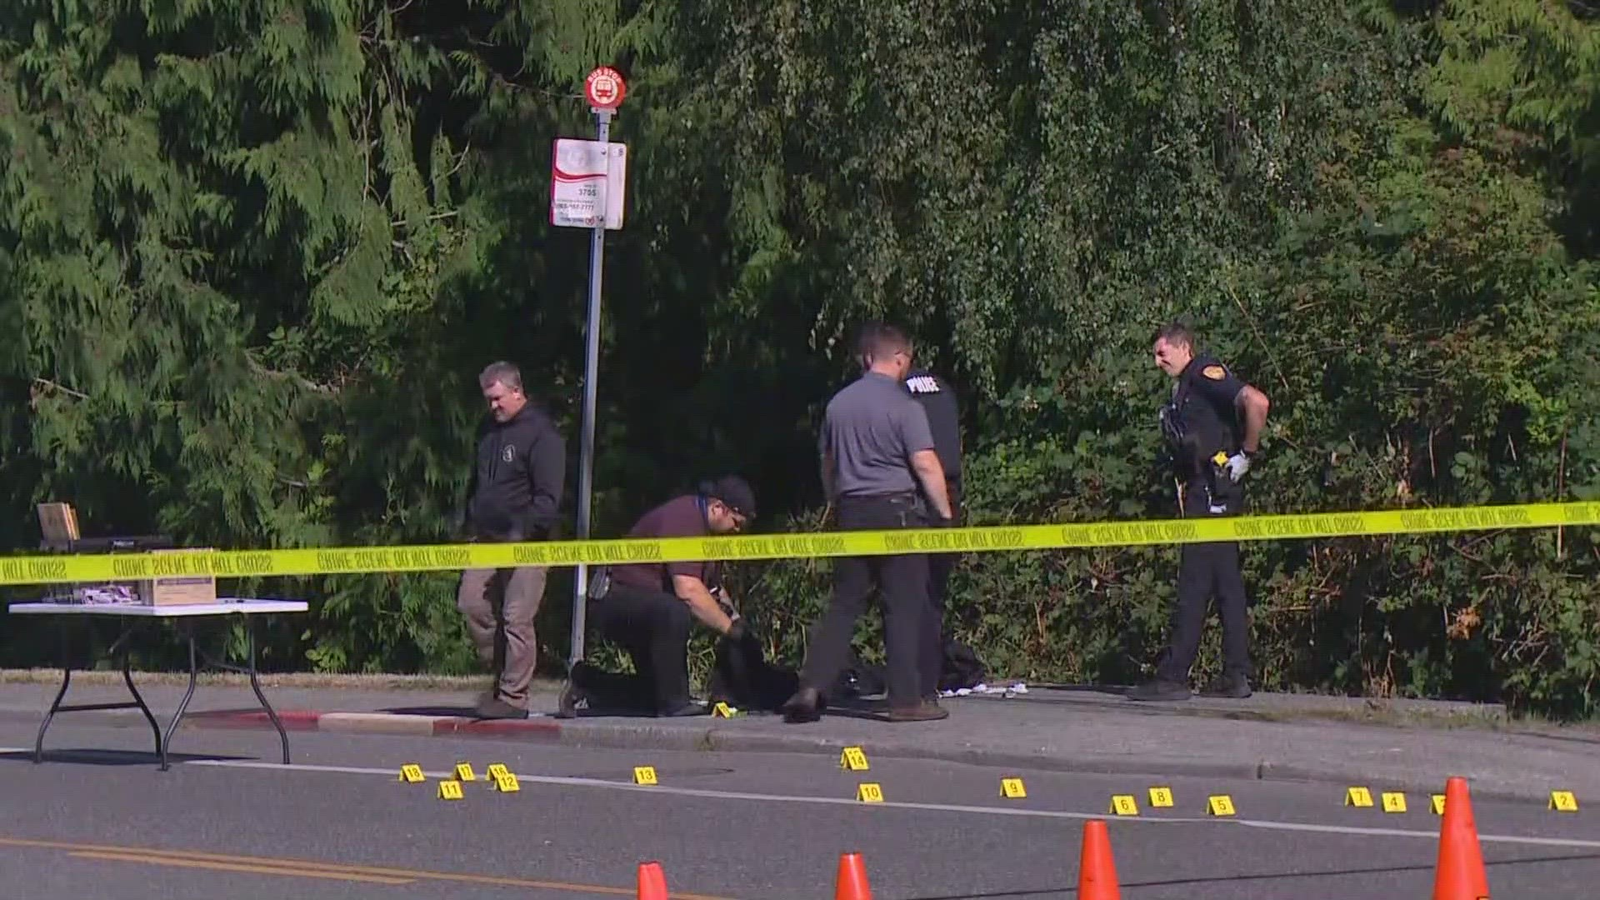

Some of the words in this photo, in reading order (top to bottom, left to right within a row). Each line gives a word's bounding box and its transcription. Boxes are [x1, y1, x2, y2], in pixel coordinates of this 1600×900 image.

[588, 69, 602, 82] BUS
[603, 69, 621, 83] STOP
[906, 376, 940, 393] POLICE
[851, 755, 864, 765] 14
[407, 768, 420, 778] 18
[639, 770, 653, 780] 13
[501, 777, 516, 787] 12
[444, 784, 457, 794] 11
[865, 787, 879, 798] 10
[1010, 783, 1018, 793] 9
[1157, 791, 1165, 802] 8
[1354, 791, 1363, 801] 7
[1390, 796, 1397, 806] 4
[1121, 800, 1129, 810] 6
[1218, 800, 1226, 810] 5
[1560, 796, 1569, 807] 2
